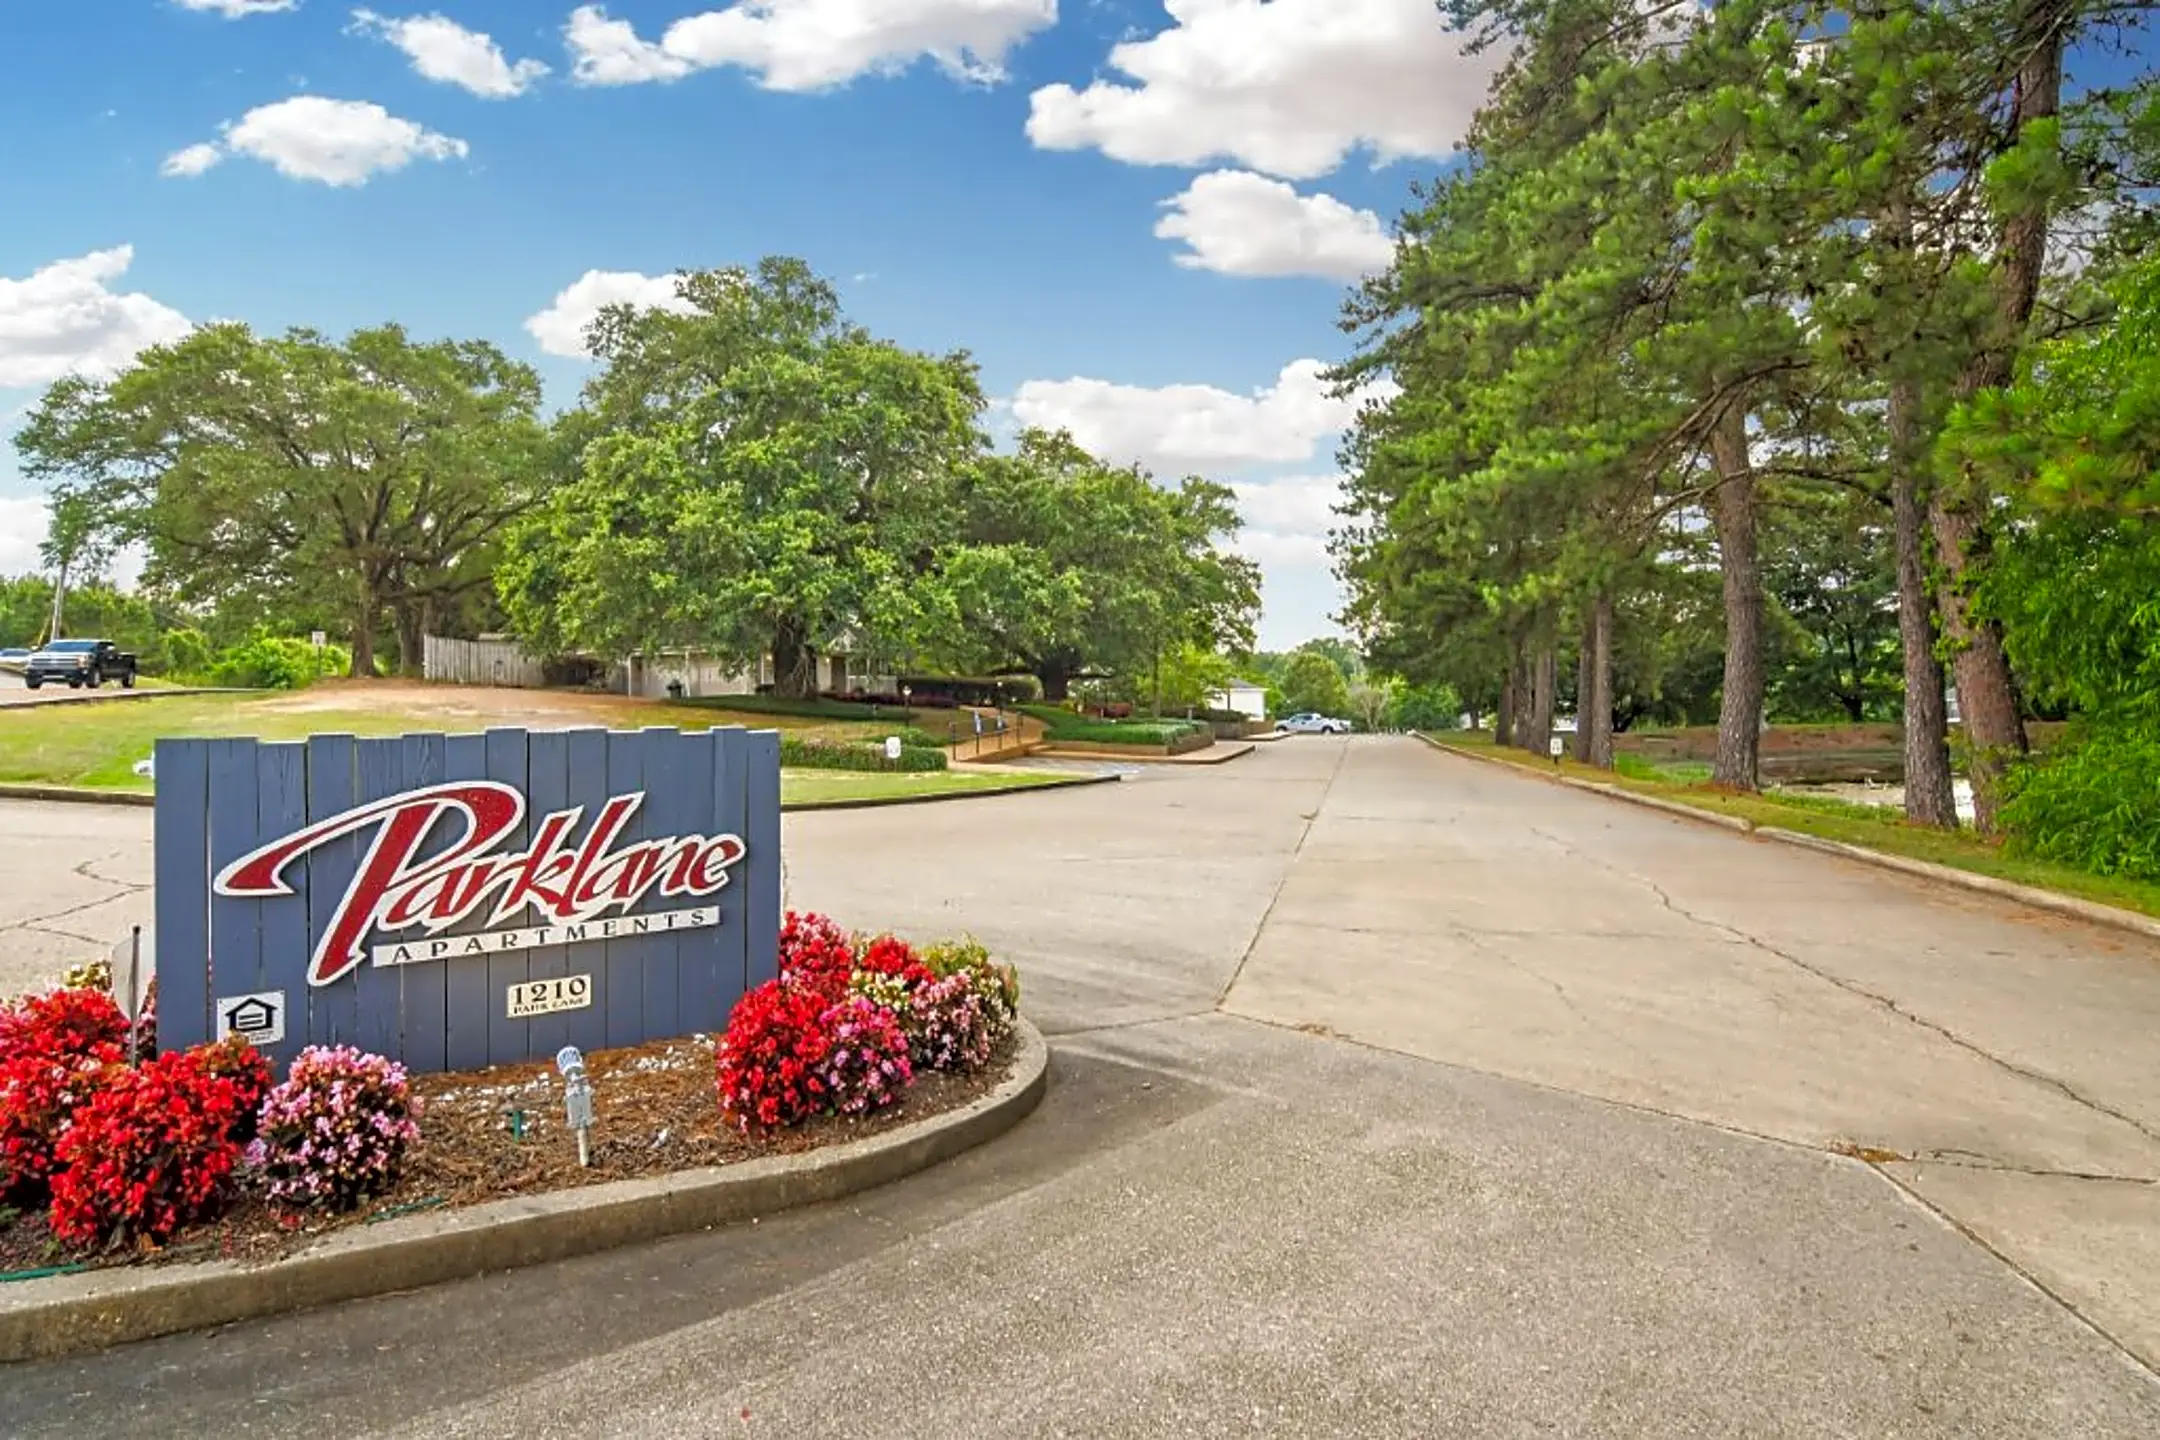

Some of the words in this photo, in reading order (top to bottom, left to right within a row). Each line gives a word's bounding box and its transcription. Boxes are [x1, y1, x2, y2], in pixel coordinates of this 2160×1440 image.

[213, 781, 746, 987] Parklane
[391, 908, 707, 965] APARTMENTS
[515, 977, 587, 1005] 1210
